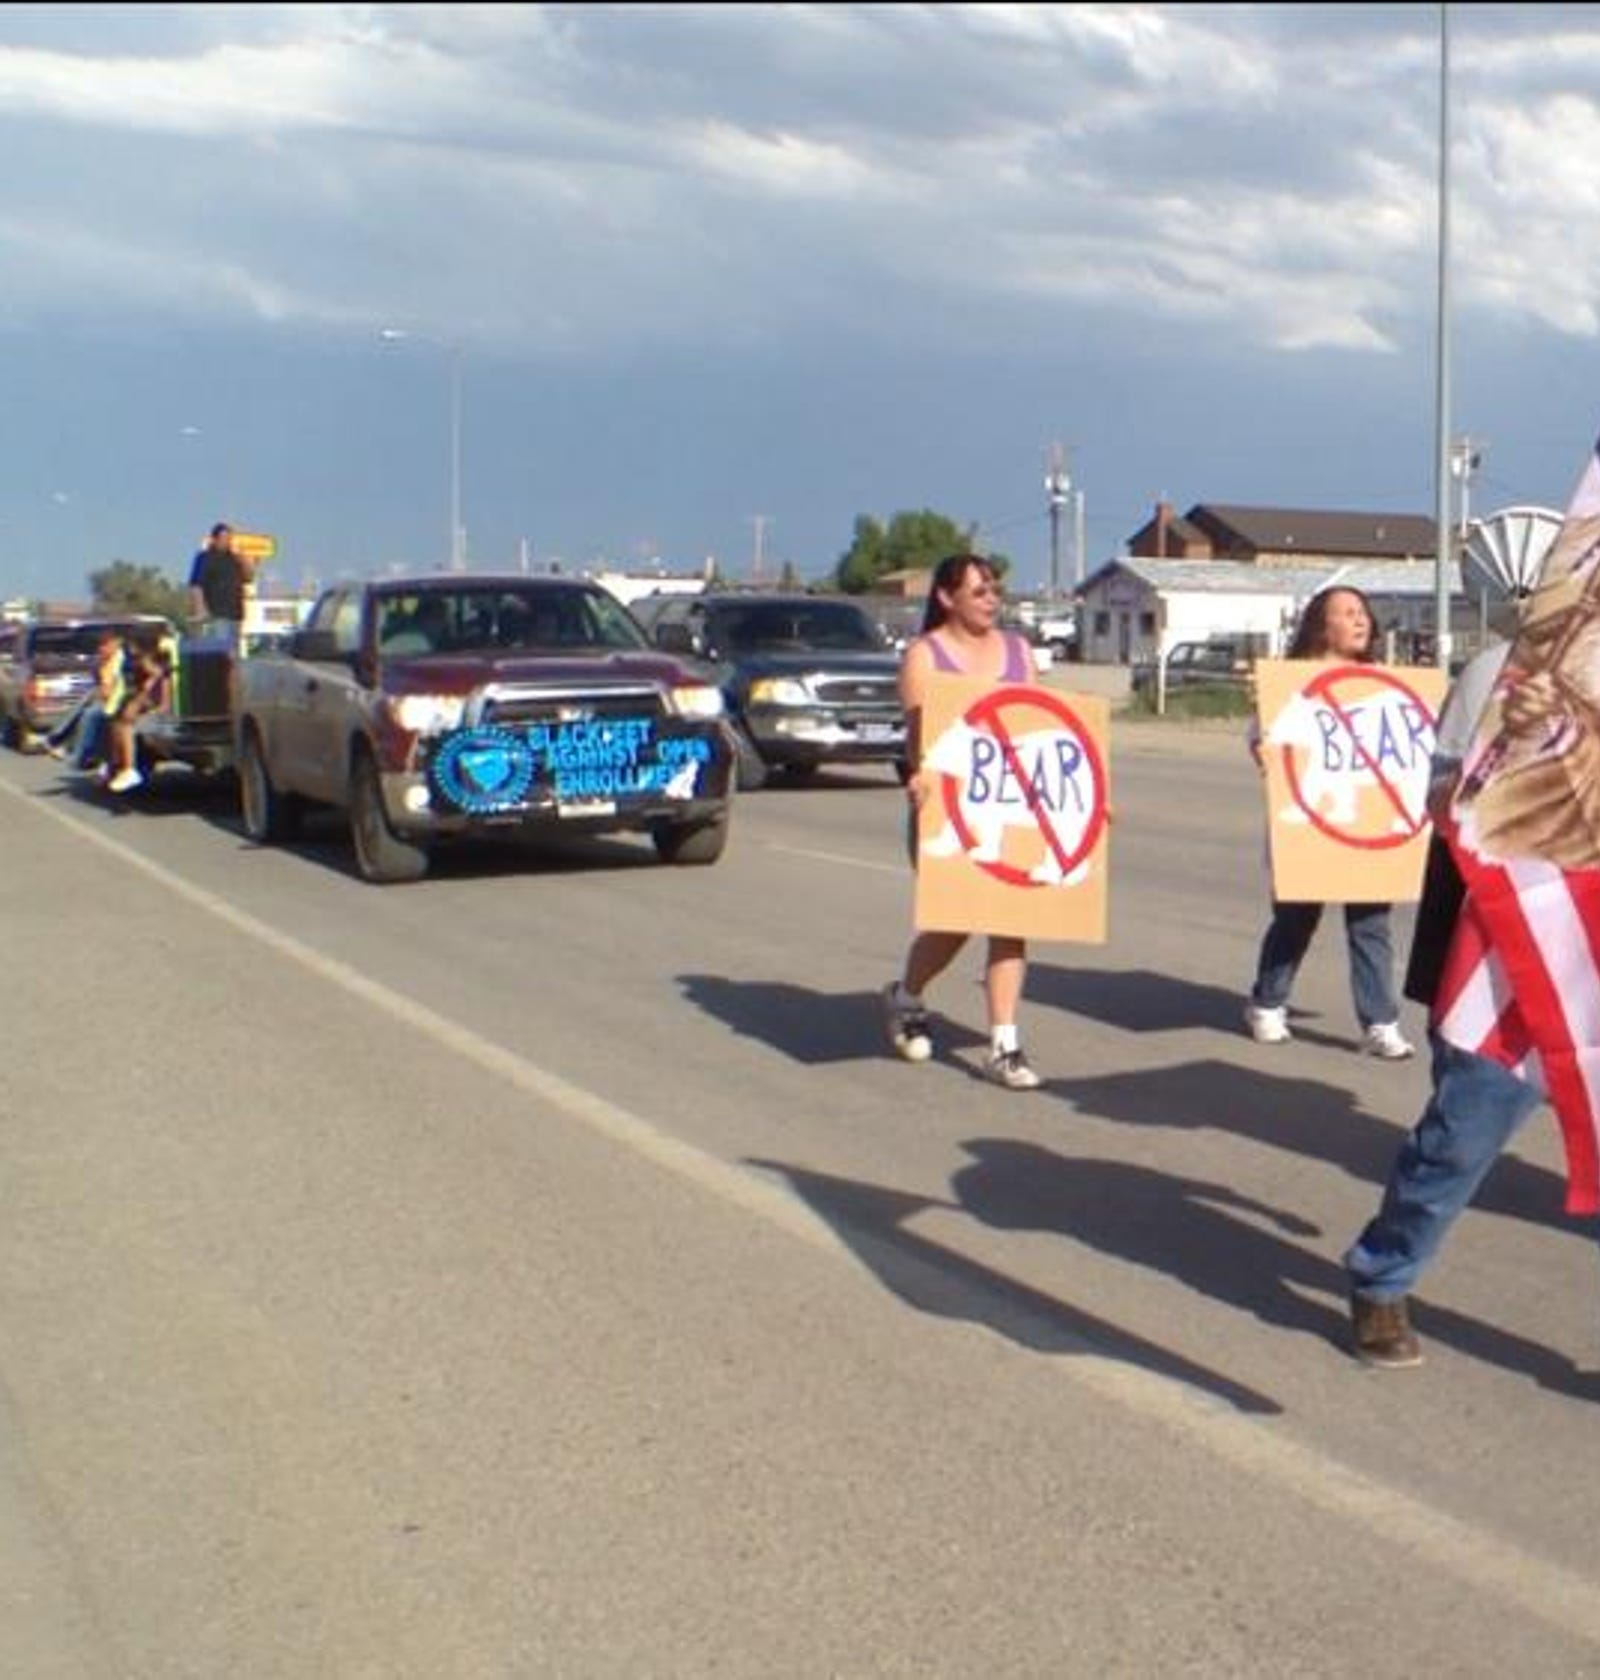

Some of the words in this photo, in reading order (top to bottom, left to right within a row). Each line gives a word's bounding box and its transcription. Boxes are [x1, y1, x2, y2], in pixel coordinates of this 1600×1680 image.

[1315, 702, 1433, 772] BEAR
[555, 763, 690, 796] ENROLLME
[967, 737, 1085, 814] BEAR
